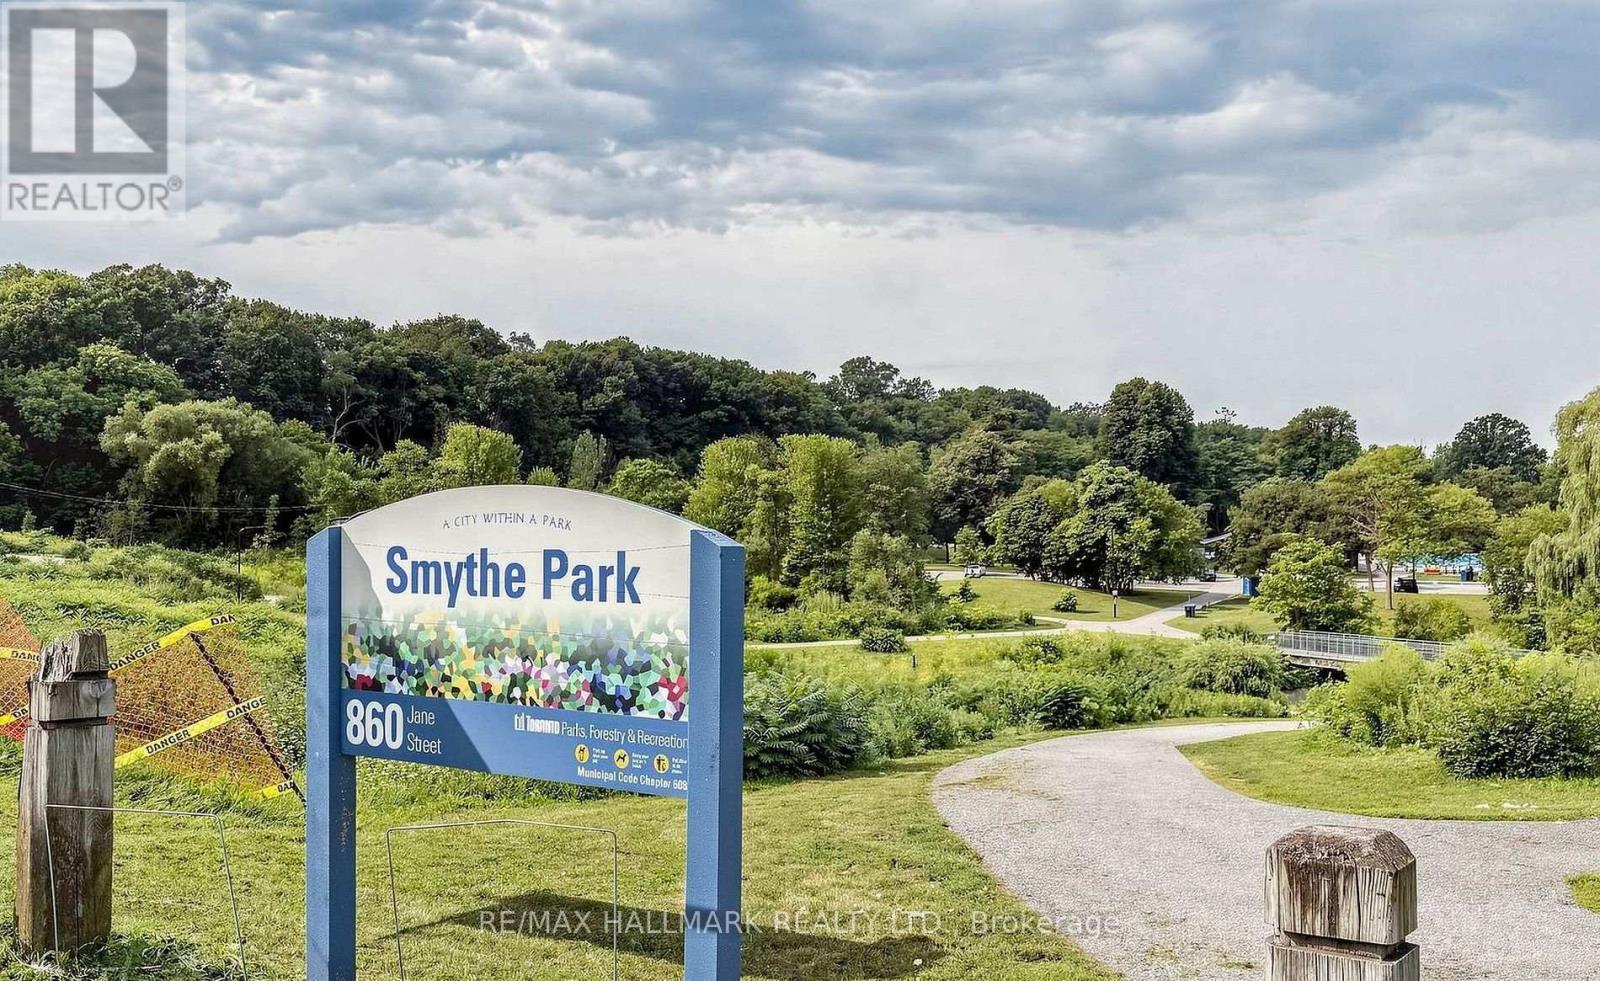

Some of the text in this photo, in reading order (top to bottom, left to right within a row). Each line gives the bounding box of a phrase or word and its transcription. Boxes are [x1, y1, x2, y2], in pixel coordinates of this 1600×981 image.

[443, 512, 572, 531] A CITY WITHIN A PARK
[386, 545, 641, 608] Smythe Park
[110, 641, 161, 671] DANGER
[346, 699, 404, 750] 860
[407, 705, 435, 725] Jane
[146, 729, 191, 754] DANGER
[407, 732, 442, 754] Street
[561, 721, 588, 739] Parks,
[589, 724, 626, 745] Forestry
[628, 728, 636, 744] &
[638, 729, 688, 749] Recreation
[577, 766, 616, 783] Municipal
[618, 772, 638, 784] Code
[640, 774, 671, 789] Chapter
